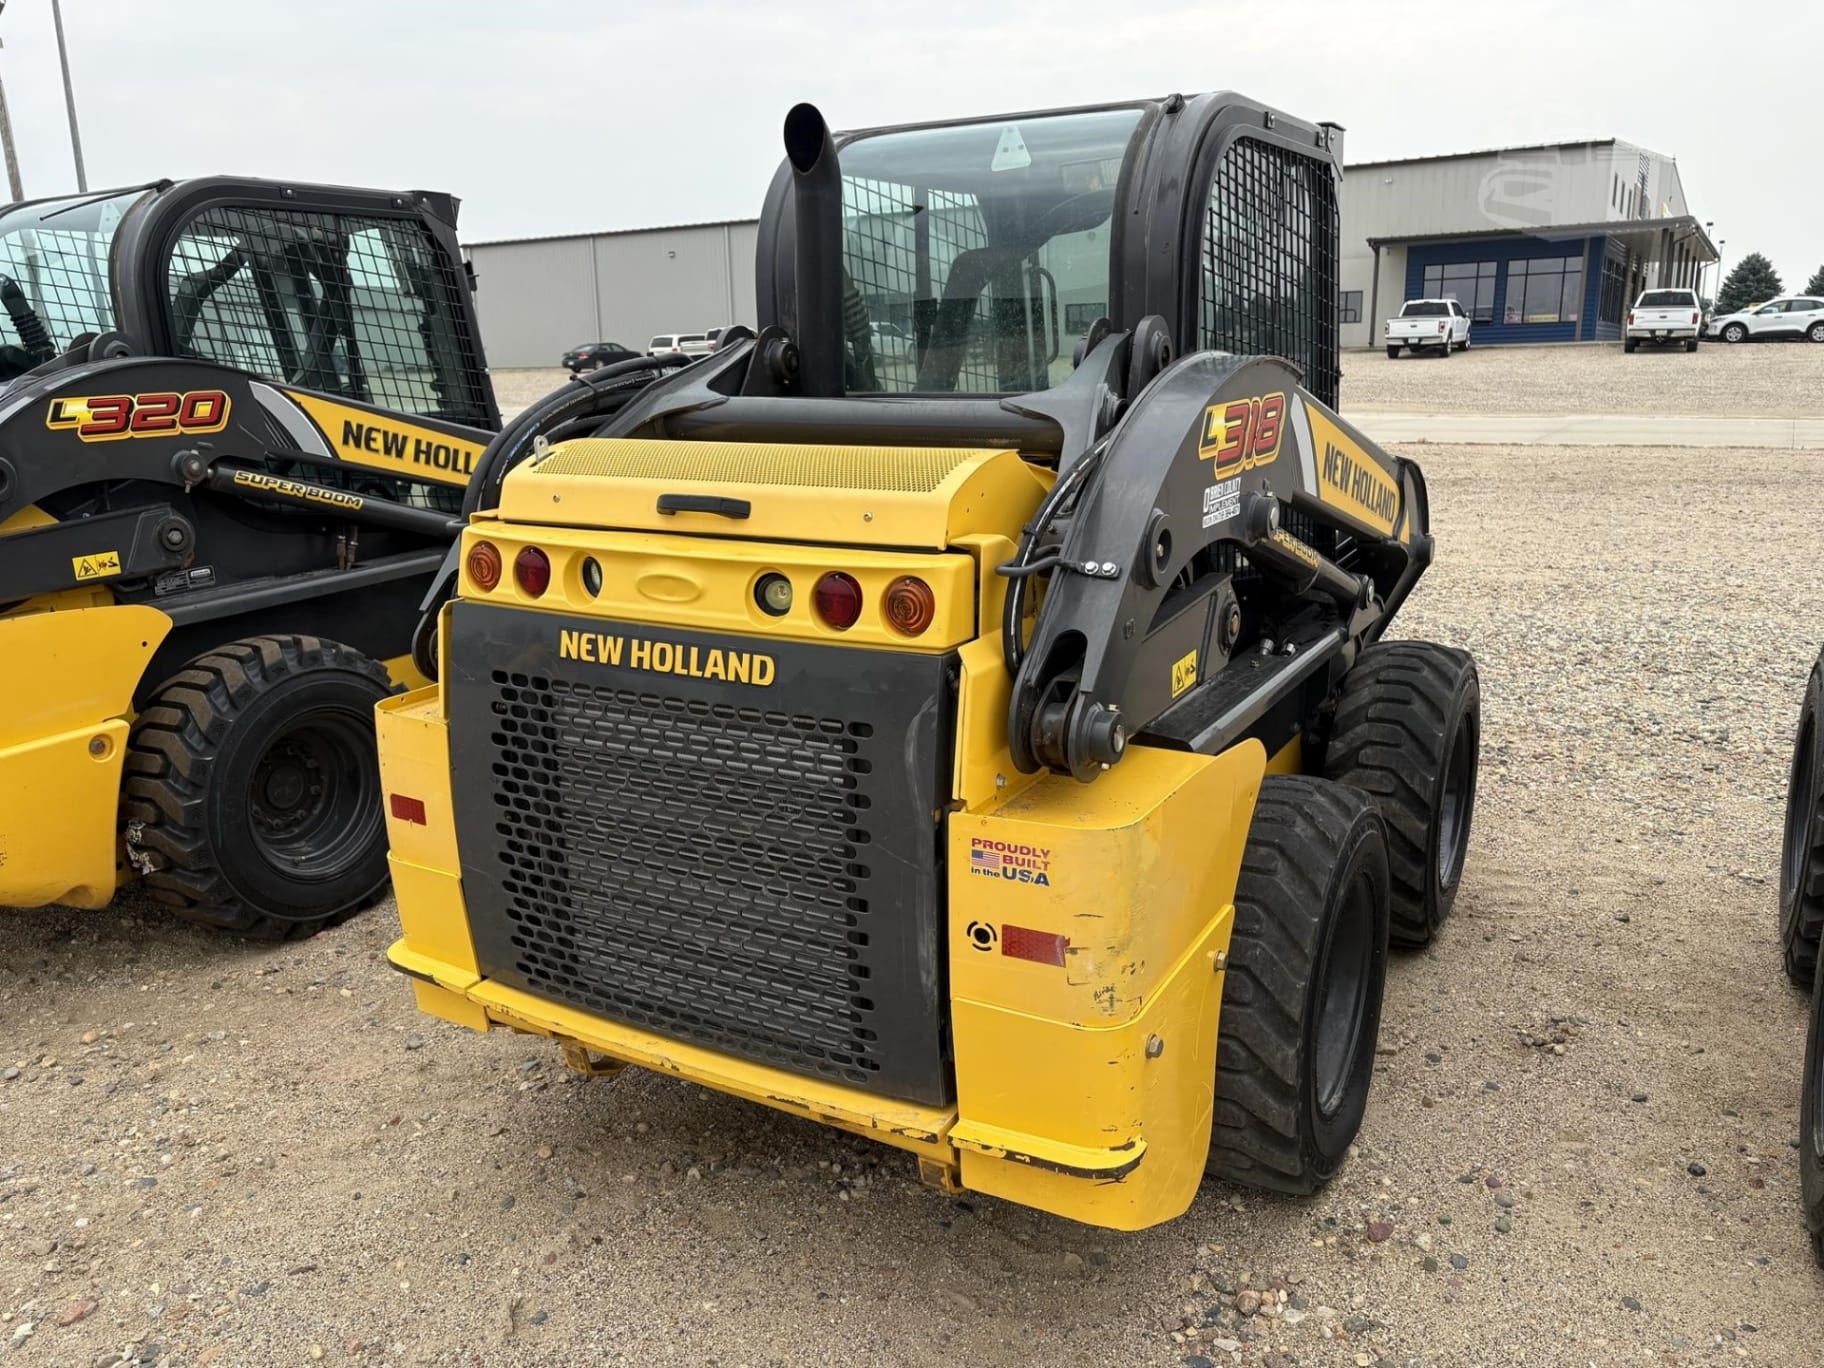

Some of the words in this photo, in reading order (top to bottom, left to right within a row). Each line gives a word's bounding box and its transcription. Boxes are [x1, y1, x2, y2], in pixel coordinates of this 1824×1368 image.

[47, 390, 232, 442] L320
[1199, 391, 1286, 480] L318
[342, 419, 408, 462] NEW
[413, 438, 475, 476] HOLL
[1322, 442, 1352, 494] NEW
[1352, 463, 1396, 523] HOLLAND
[559, 630, 624, 664] NEW
[631, 639, 775, 687] HOLLAND
[971, 838, 1050, 860] PROUDLY
[971, 867, 981, 875] in
[983, 868, 1000, 879] the
[1002, 866, 1050, 886] USA
[1002, 854, 1050, 872] BUILT
